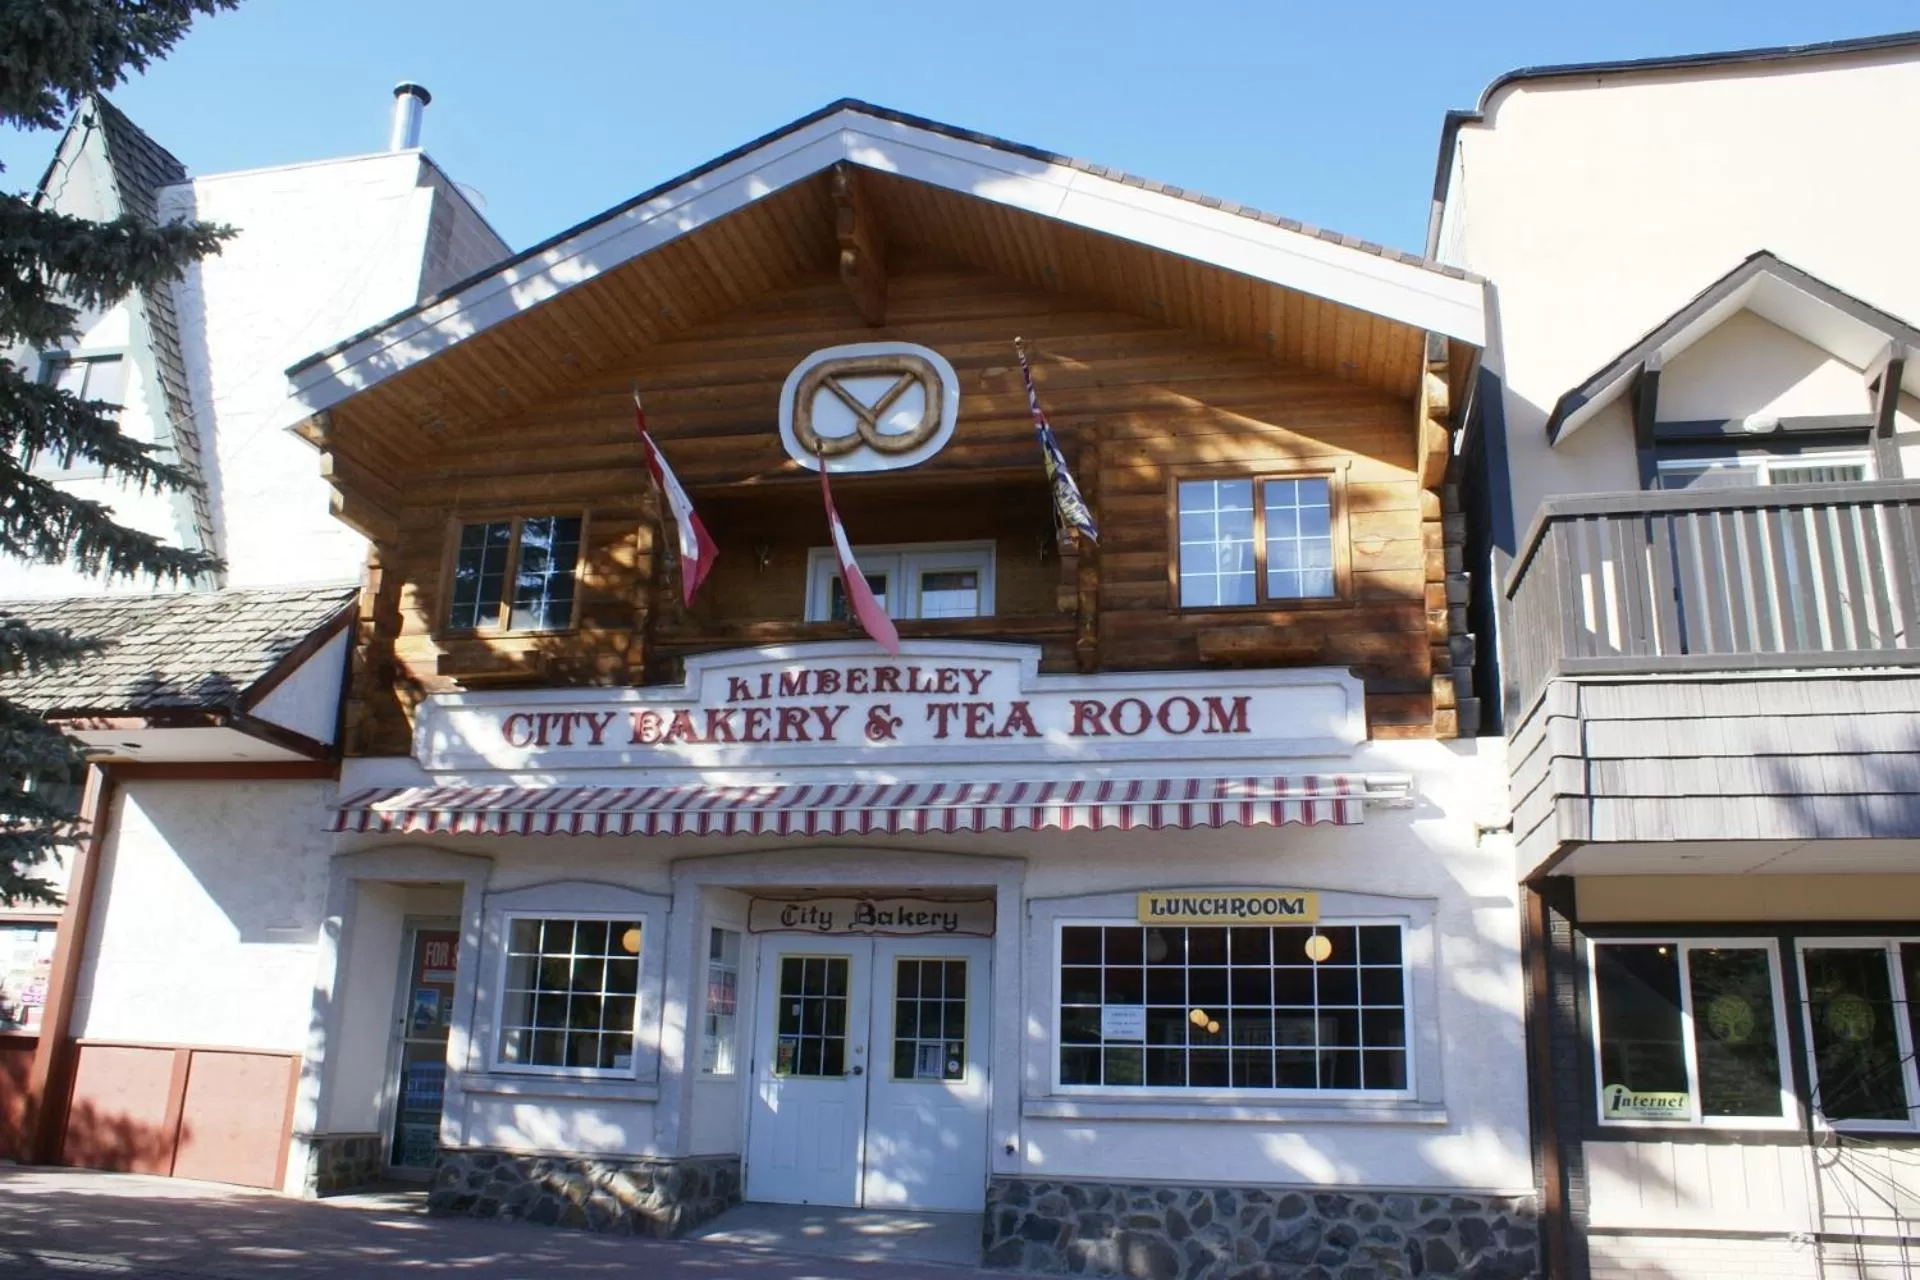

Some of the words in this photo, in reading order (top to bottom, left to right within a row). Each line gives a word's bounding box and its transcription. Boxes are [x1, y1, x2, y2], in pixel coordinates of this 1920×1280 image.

[727, 666, 992, 702] KIMBERLEY
[502, 711, 617, 748] CITY
[627, 705, 849, 745] BAKERY
[864, 702, 903, 741] &
[927, 701, 1043, 739] TEA
[1069, 696, 1252, 737] ROOM
[780, 903, 832, 931] City
[848, 901, 959, 932] Bakery
[1150, 897, 1305, 918] LUNCHROOM
[424, 941, 450, 967] FOR
[1611, 1087, 1684, 1111] internet
